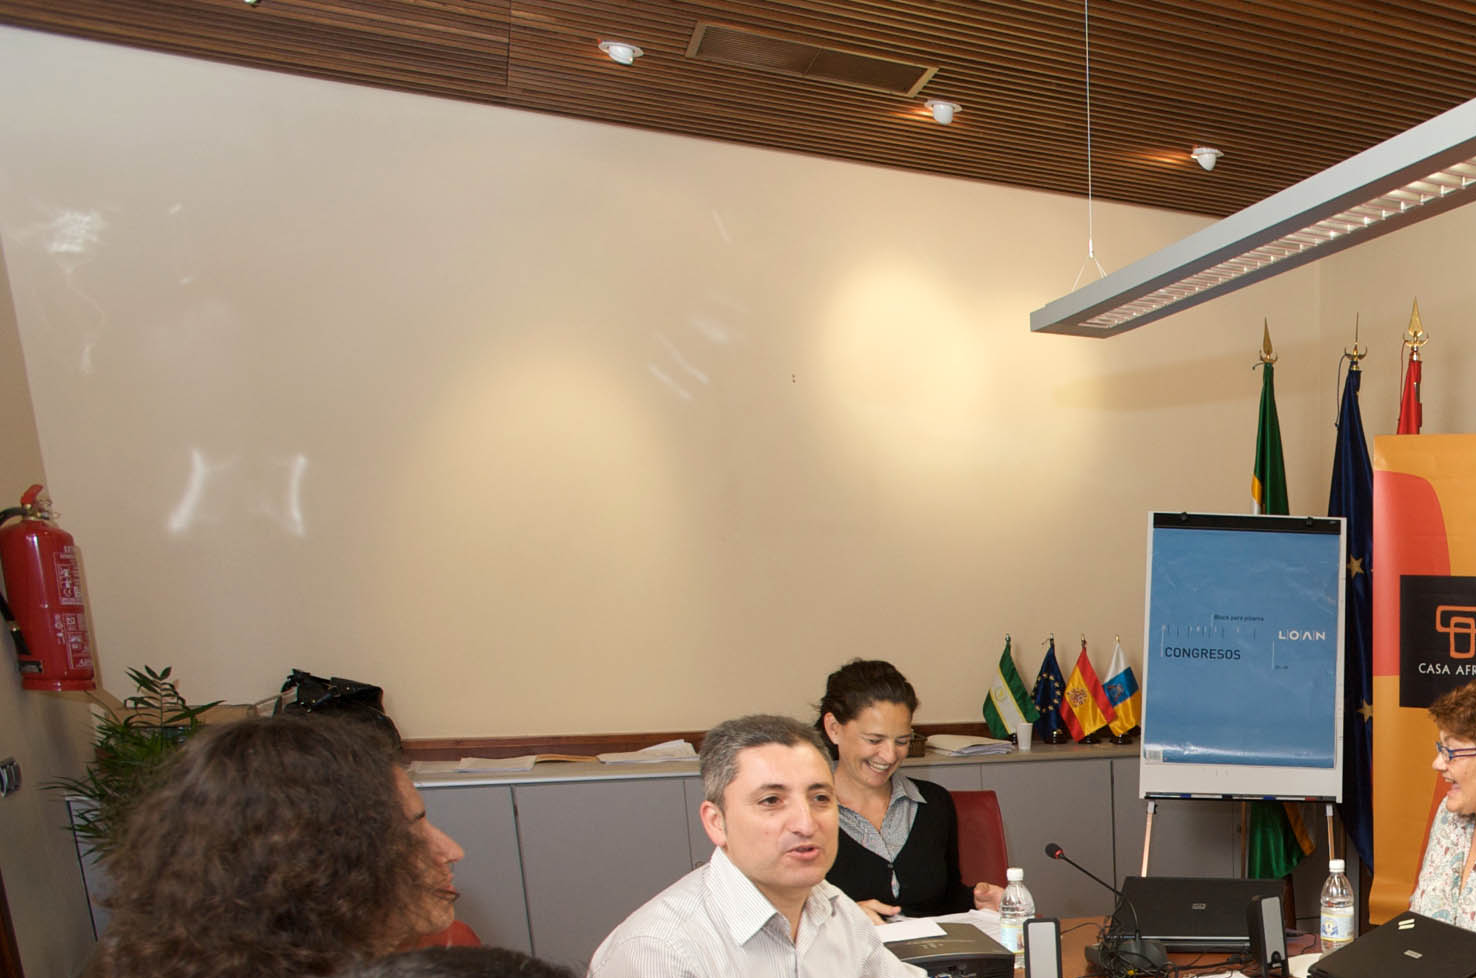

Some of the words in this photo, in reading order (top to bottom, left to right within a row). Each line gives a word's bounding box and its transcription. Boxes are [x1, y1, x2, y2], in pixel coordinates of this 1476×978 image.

[1278, 630, 1325, 640] LOAN
[1165, 647, 1240, 660] CONGRESOS
[1418, 662, 1451, 676] CASA
